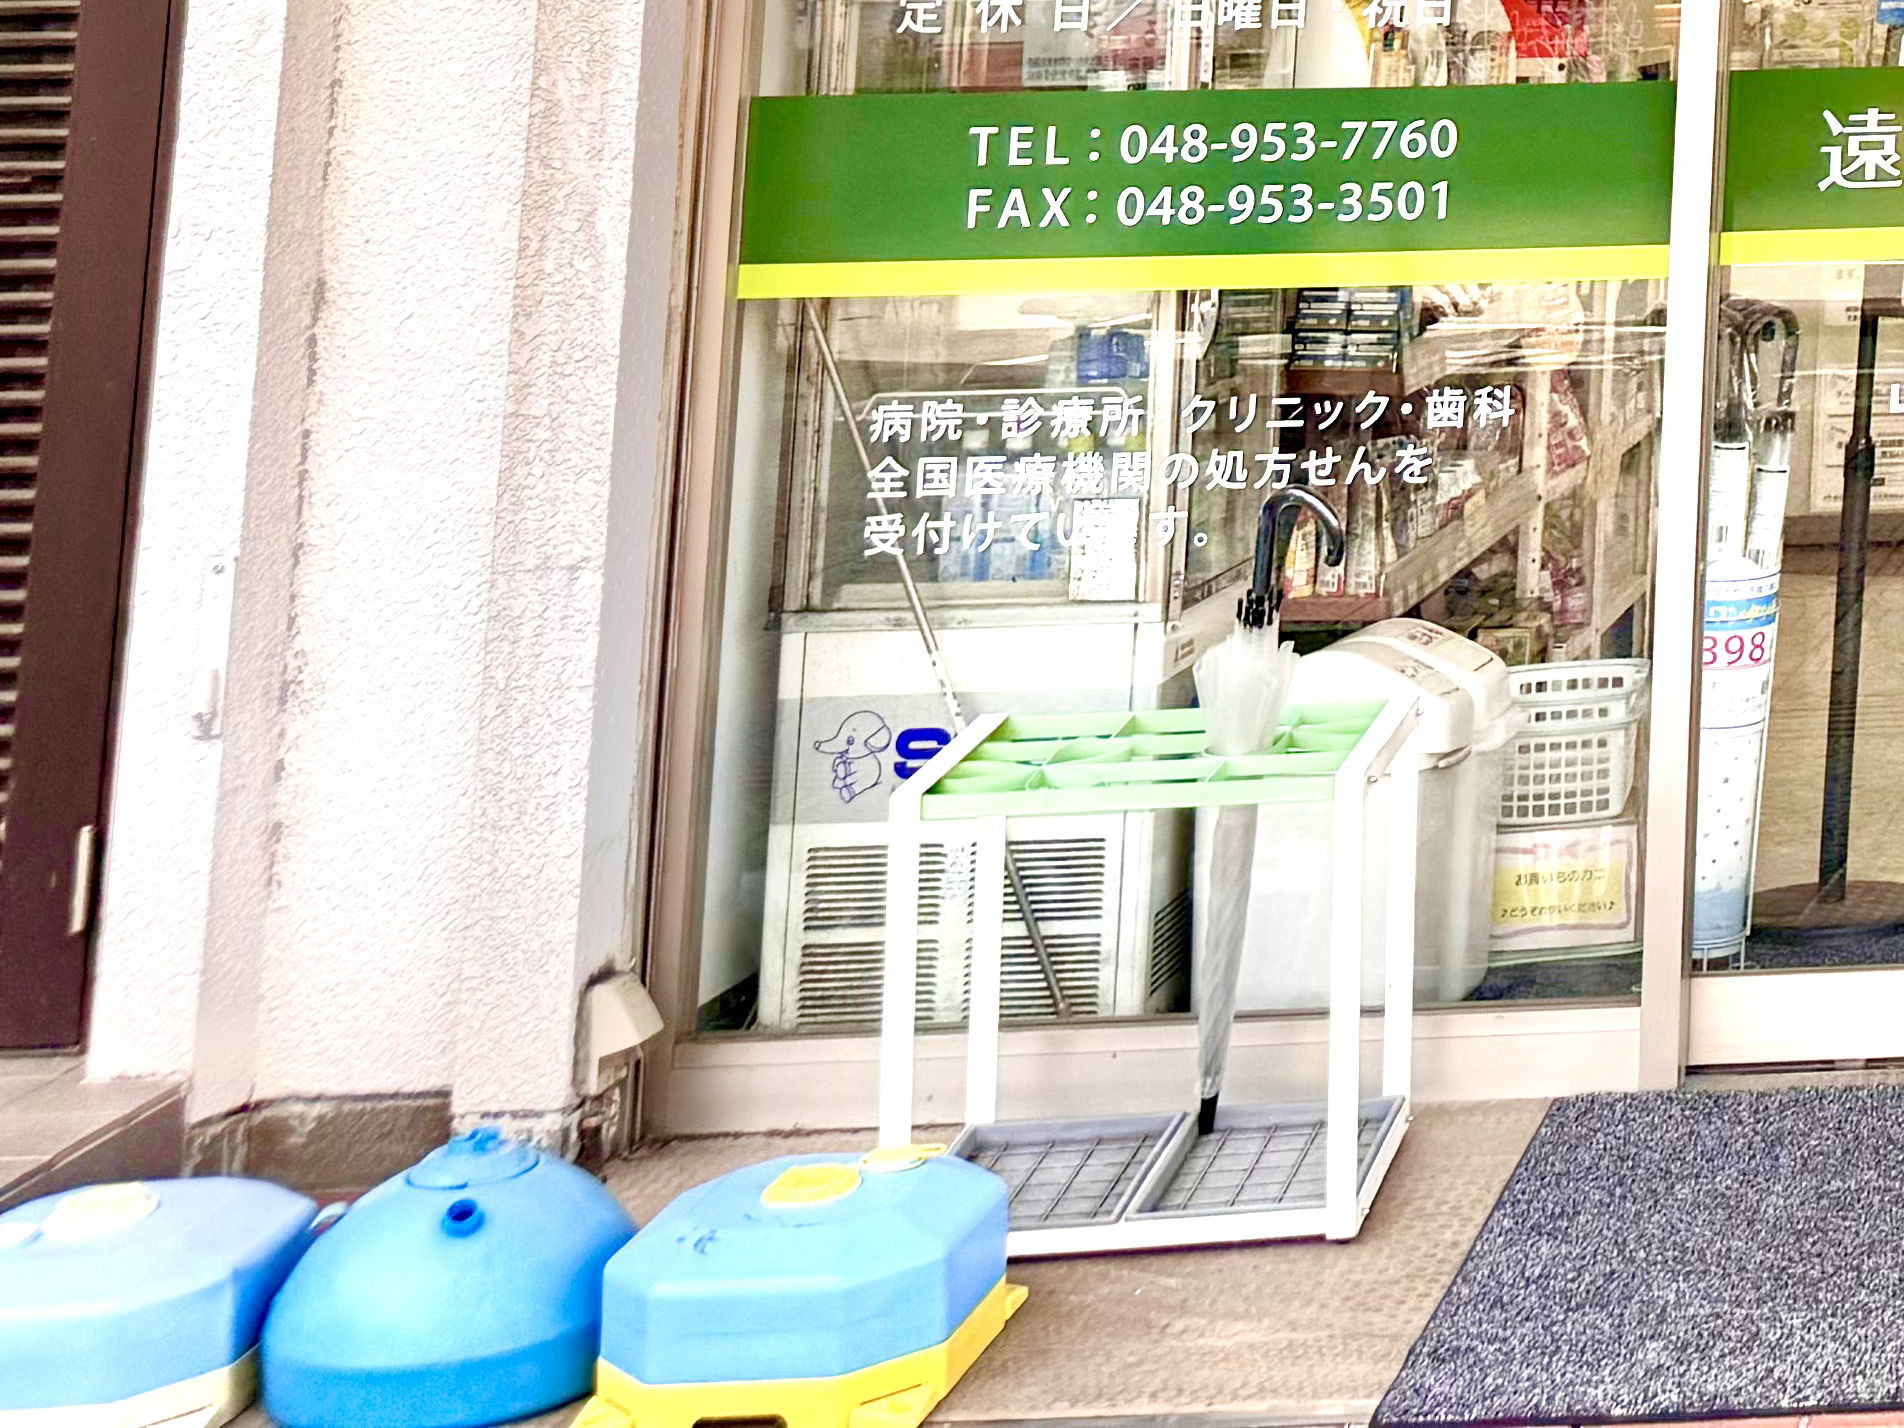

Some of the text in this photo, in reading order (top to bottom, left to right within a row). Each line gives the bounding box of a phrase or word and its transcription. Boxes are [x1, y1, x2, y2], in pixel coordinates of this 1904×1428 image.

[866, 443, 1434, 500] 全国医療機関の処方せんを
